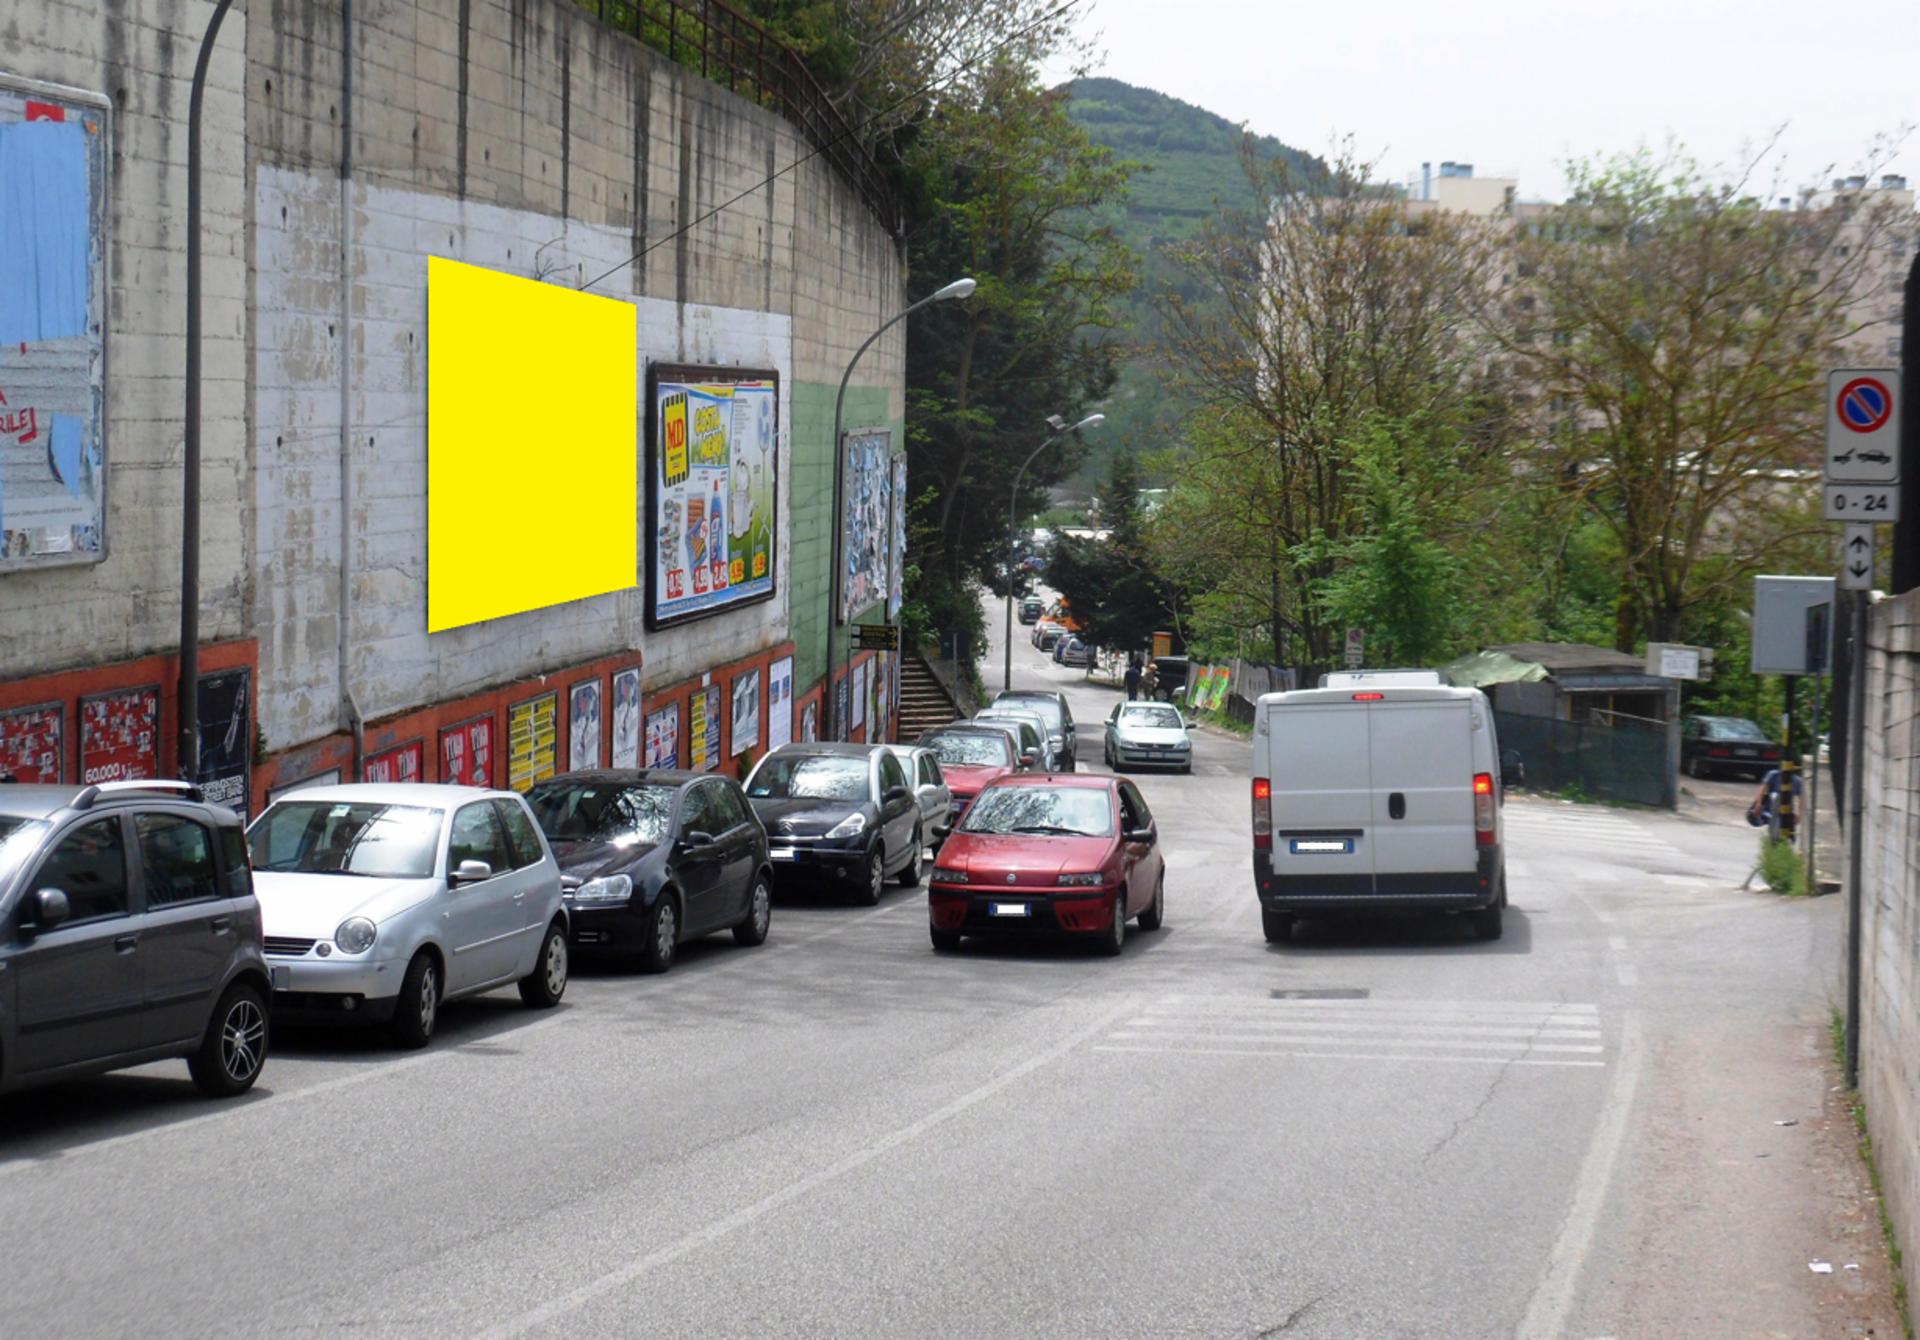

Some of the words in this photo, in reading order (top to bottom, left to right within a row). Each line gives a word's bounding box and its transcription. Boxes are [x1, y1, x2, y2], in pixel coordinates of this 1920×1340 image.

[667, 417, 684, 451] MD
[1835, 494, 1846, 511] 0
[1864, 494, 1888, 511] 24
[85, 762, 120, 784] 60.000
